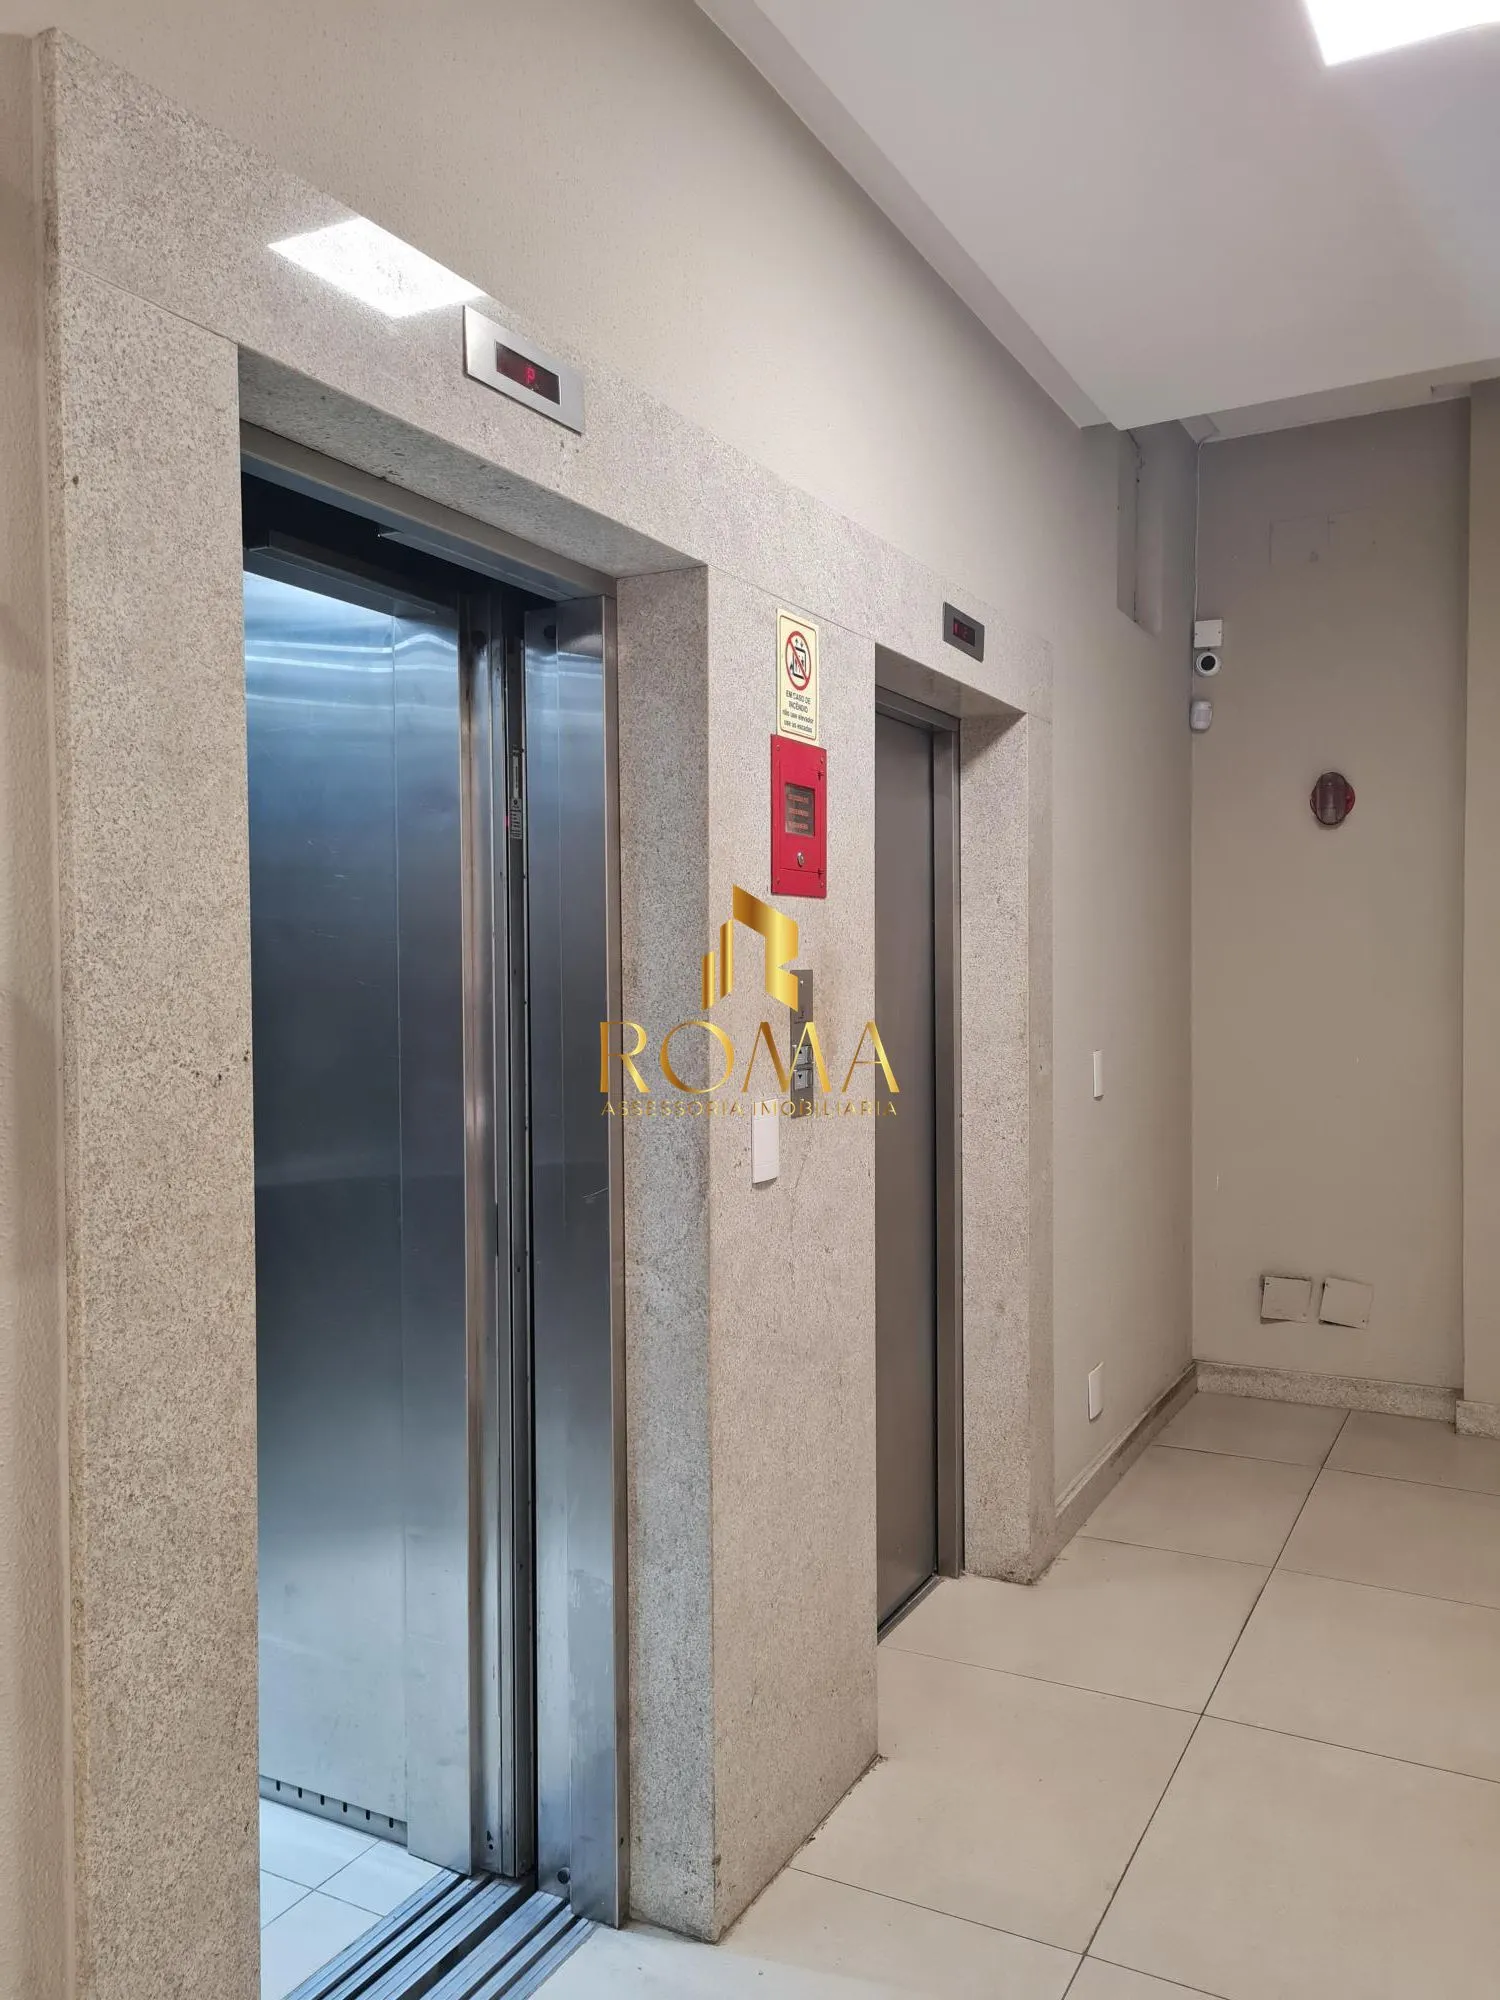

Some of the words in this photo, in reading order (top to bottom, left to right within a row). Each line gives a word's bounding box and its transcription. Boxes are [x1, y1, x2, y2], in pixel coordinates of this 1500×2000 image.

[524, 367, 536, 385] P
[786, 690, 793, 699] EM
[793, 692, 805, 703] CASO
[805, 696, 812, 705] DE
